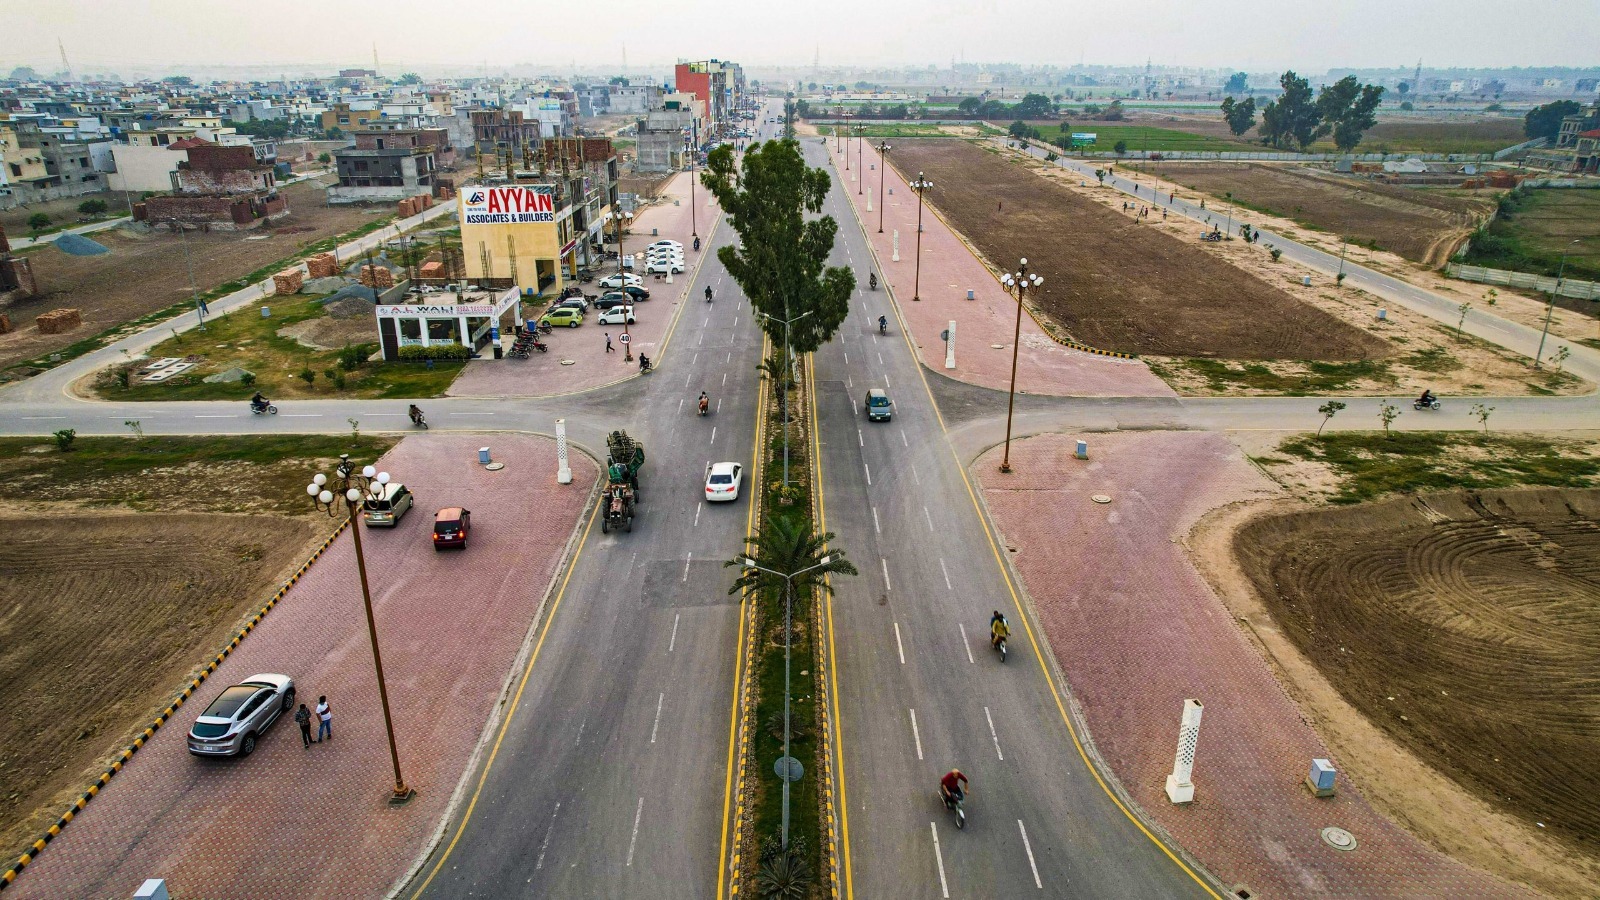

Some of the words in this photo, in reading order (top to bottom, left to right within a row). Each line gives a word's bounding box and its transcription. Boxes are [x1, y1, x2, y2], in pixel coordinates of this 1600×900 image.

[488, 188, 552, 213] AYYAN
[467, 214, 509, 223] ASSOCIATES
[511, 213, 517, 222] &
[519, 213, 553, 222] BUILDERS
